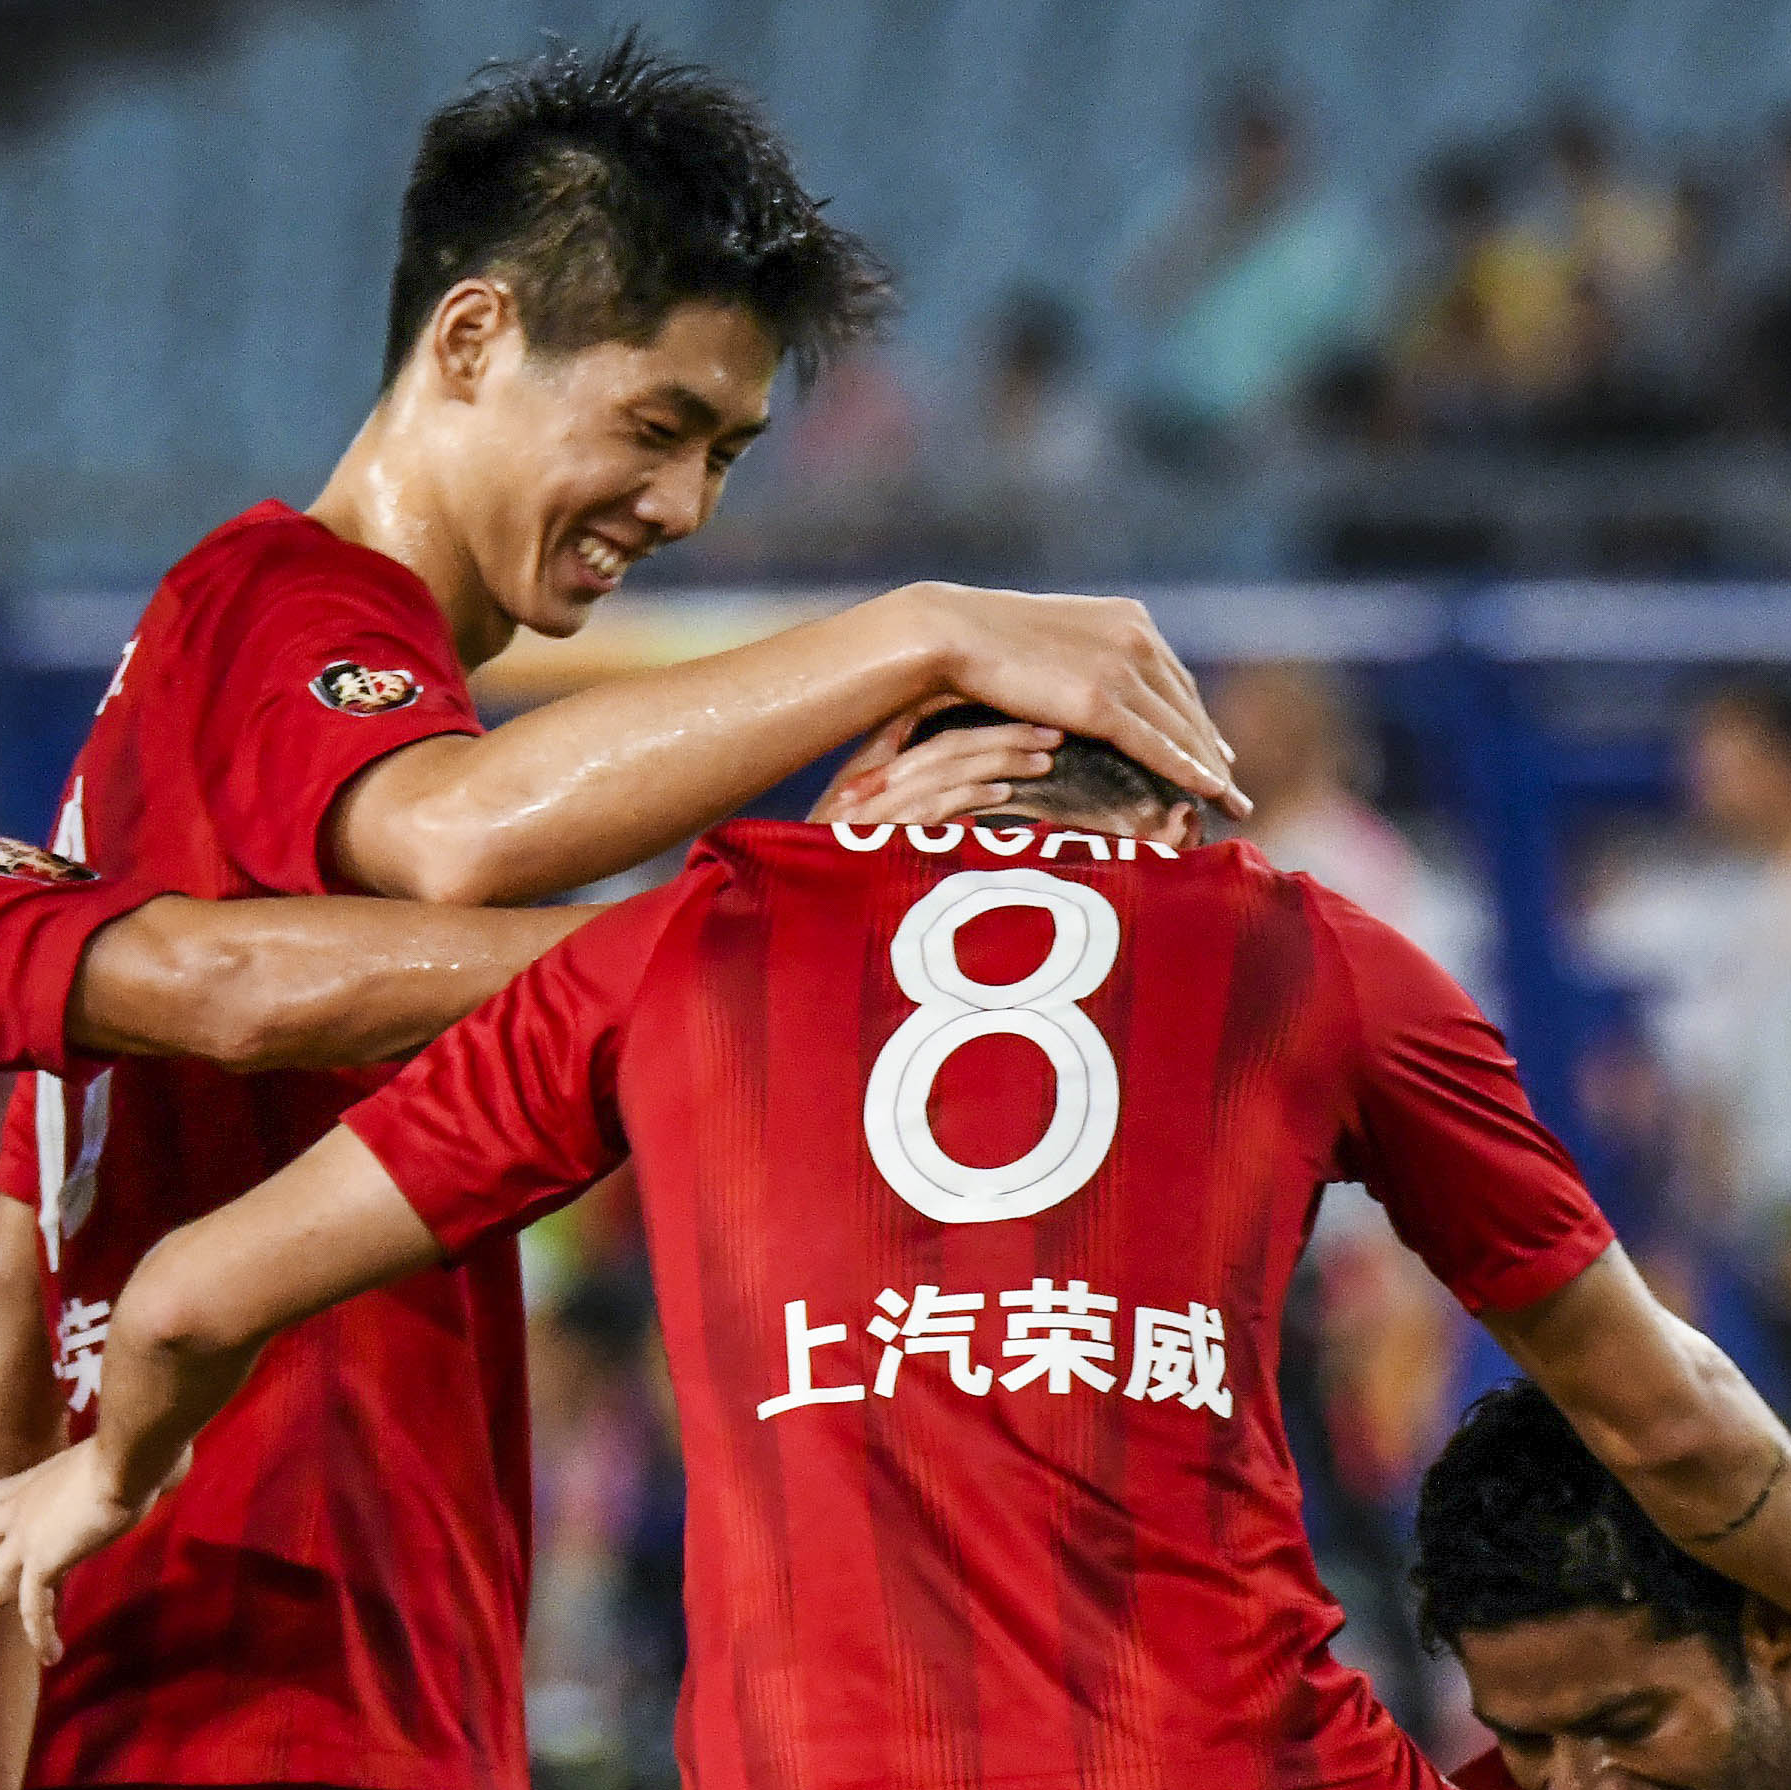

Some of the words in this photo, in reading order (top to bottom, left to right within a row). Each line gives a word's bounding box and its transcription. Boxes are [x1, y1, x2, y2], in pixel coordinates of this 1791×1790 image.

[864, 867, 1120, 1223] 8
[756, 1277, 1233, 1421] 上汽荣威
